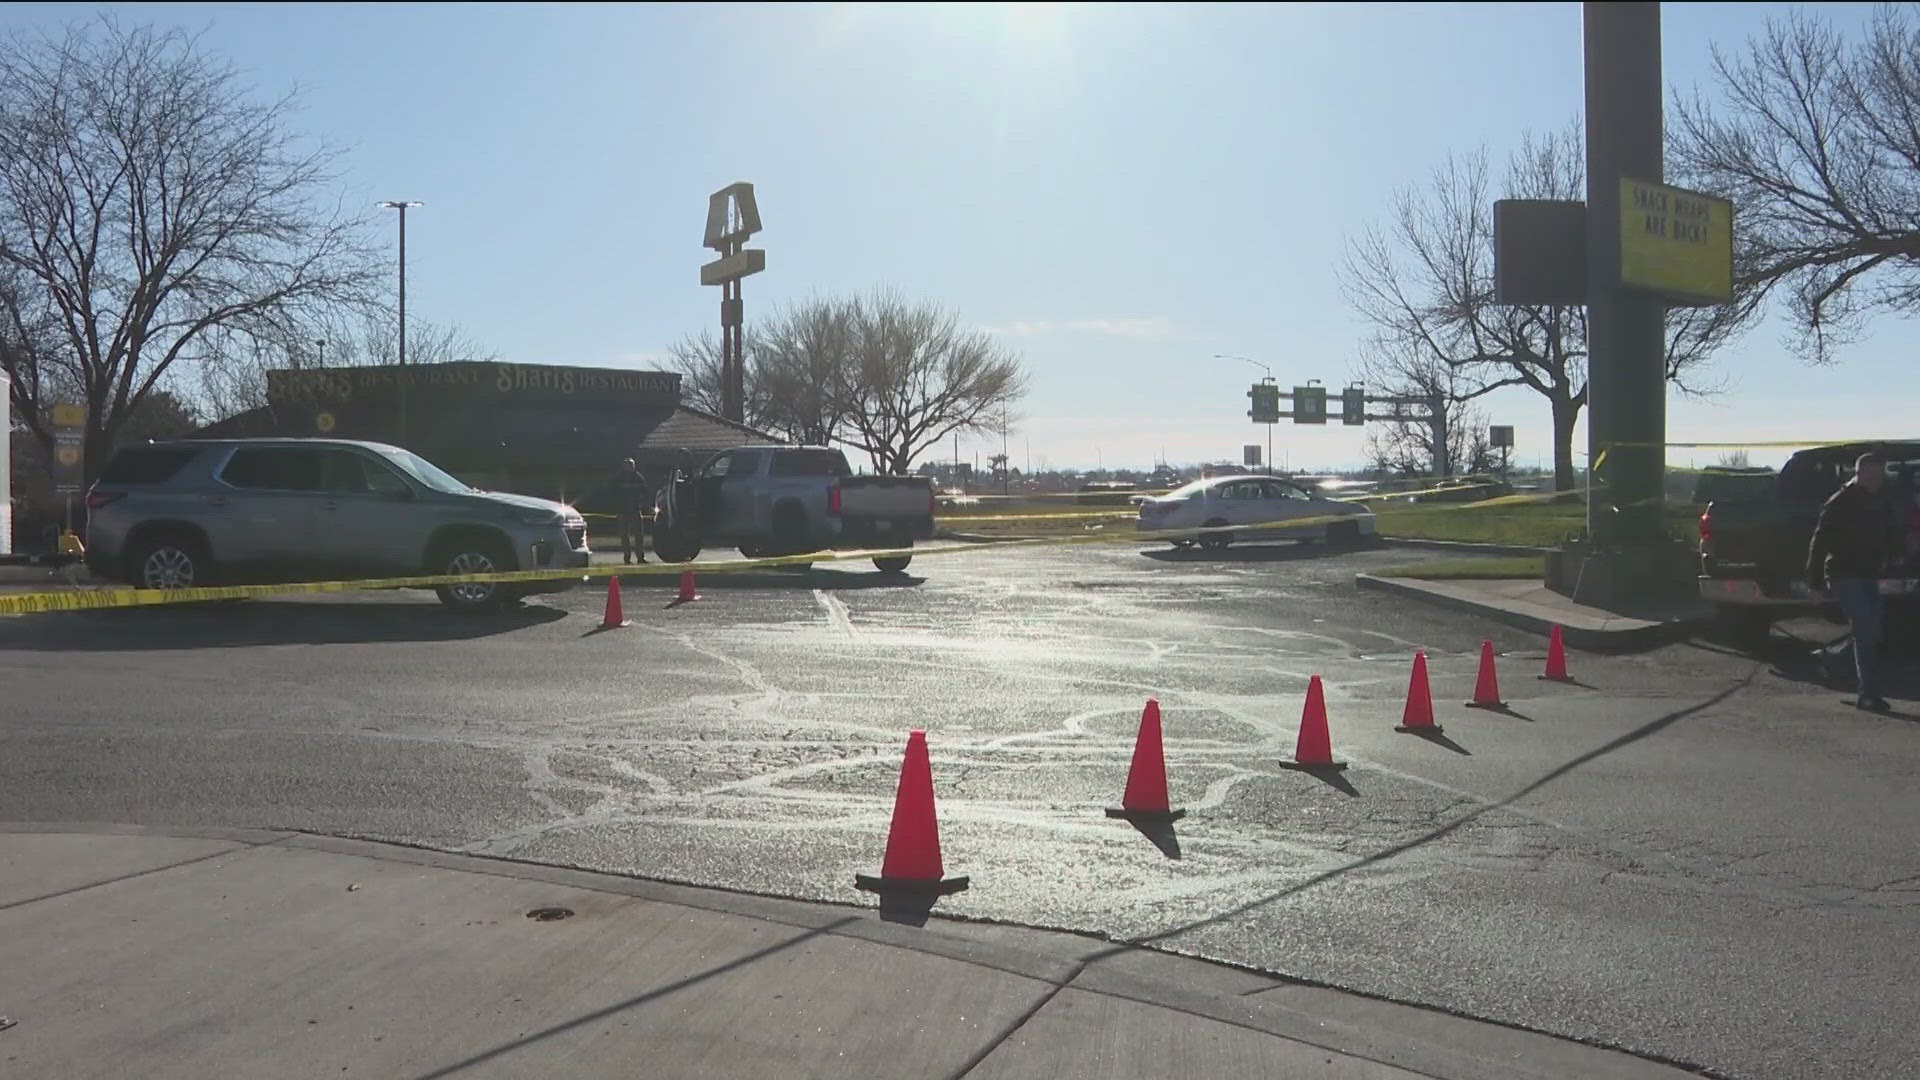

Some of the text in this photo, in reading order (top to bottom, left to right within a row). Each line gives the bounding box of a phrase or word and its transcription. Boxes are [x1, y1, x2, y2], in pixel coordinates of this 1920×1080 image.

[1633, 186, 1709, 222] SNACK WRAPS
[1646, 215, 1707, 244] ARE BACK!
[580, 373, 677, 392] RESTAURANT
